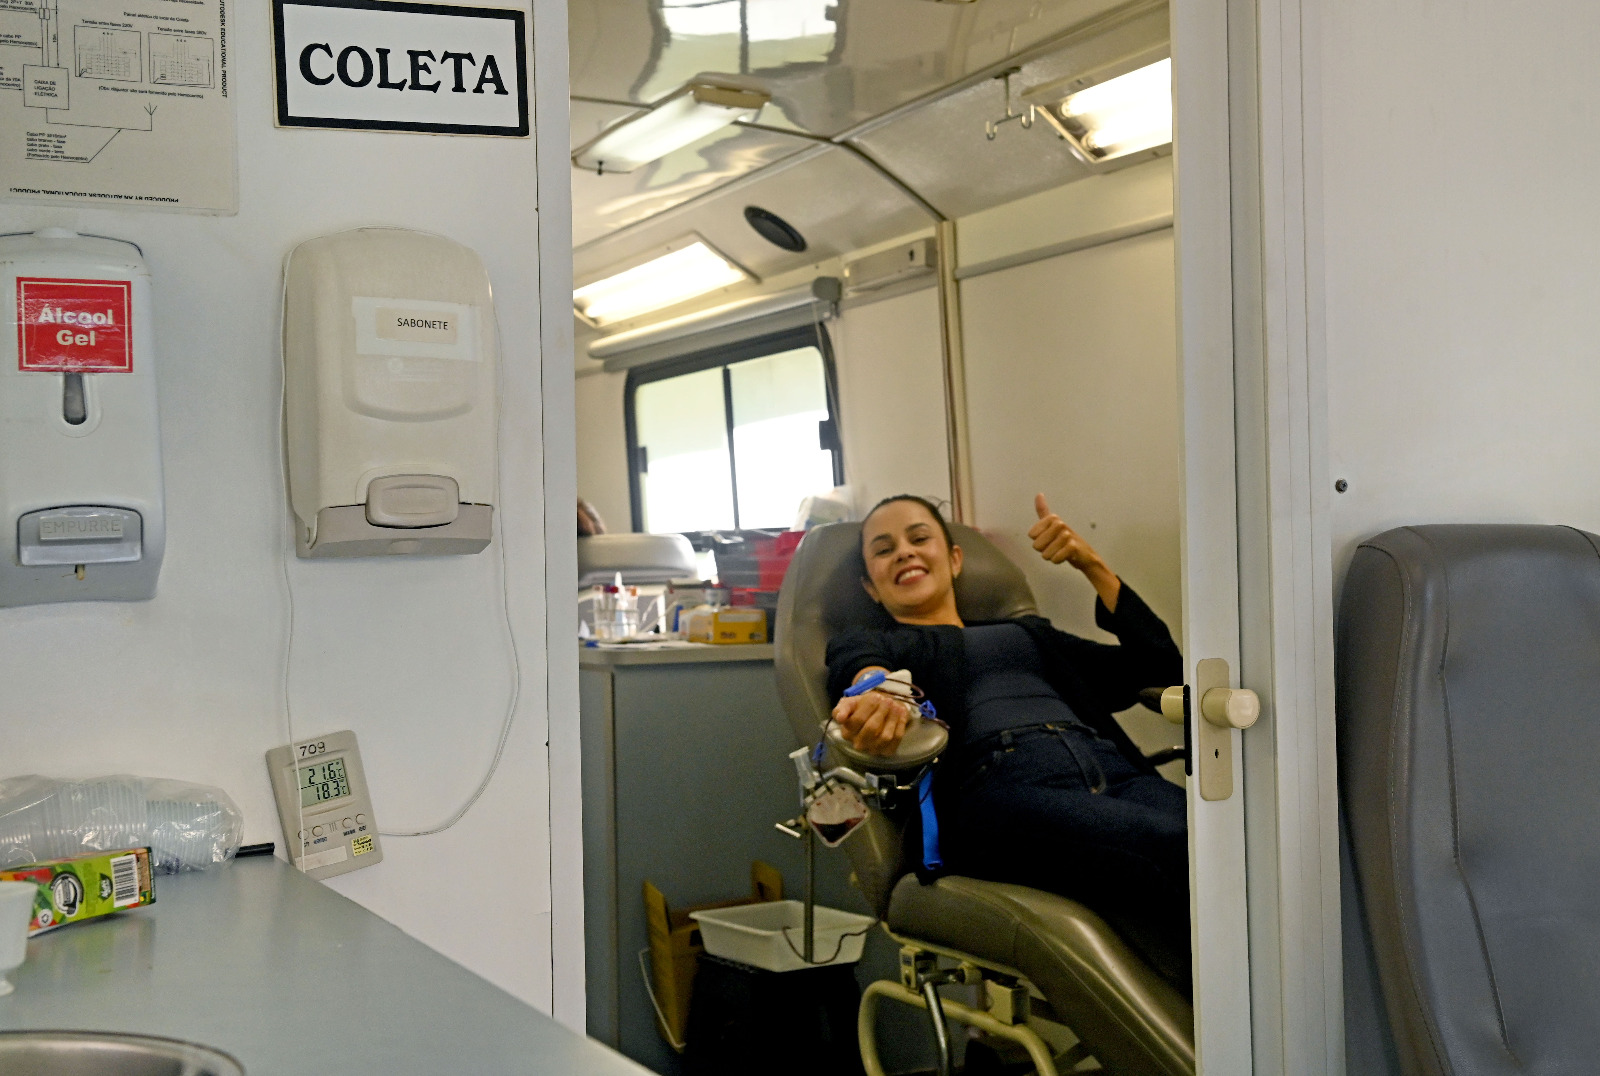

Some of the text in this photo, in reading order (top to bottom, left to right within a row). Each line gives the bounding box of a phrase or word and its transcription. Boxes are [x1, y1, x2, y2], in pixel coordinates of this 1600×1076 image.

[299, 42, 509, 95] COLETA
[38, 303, 114, 325] Álcool
[397, 317, 448, 330] SABONETE
[56, 329, 96, 346] Gel
[42, 519, 121, 534] EMPURRE
[299, 741, 326, 756] 709
